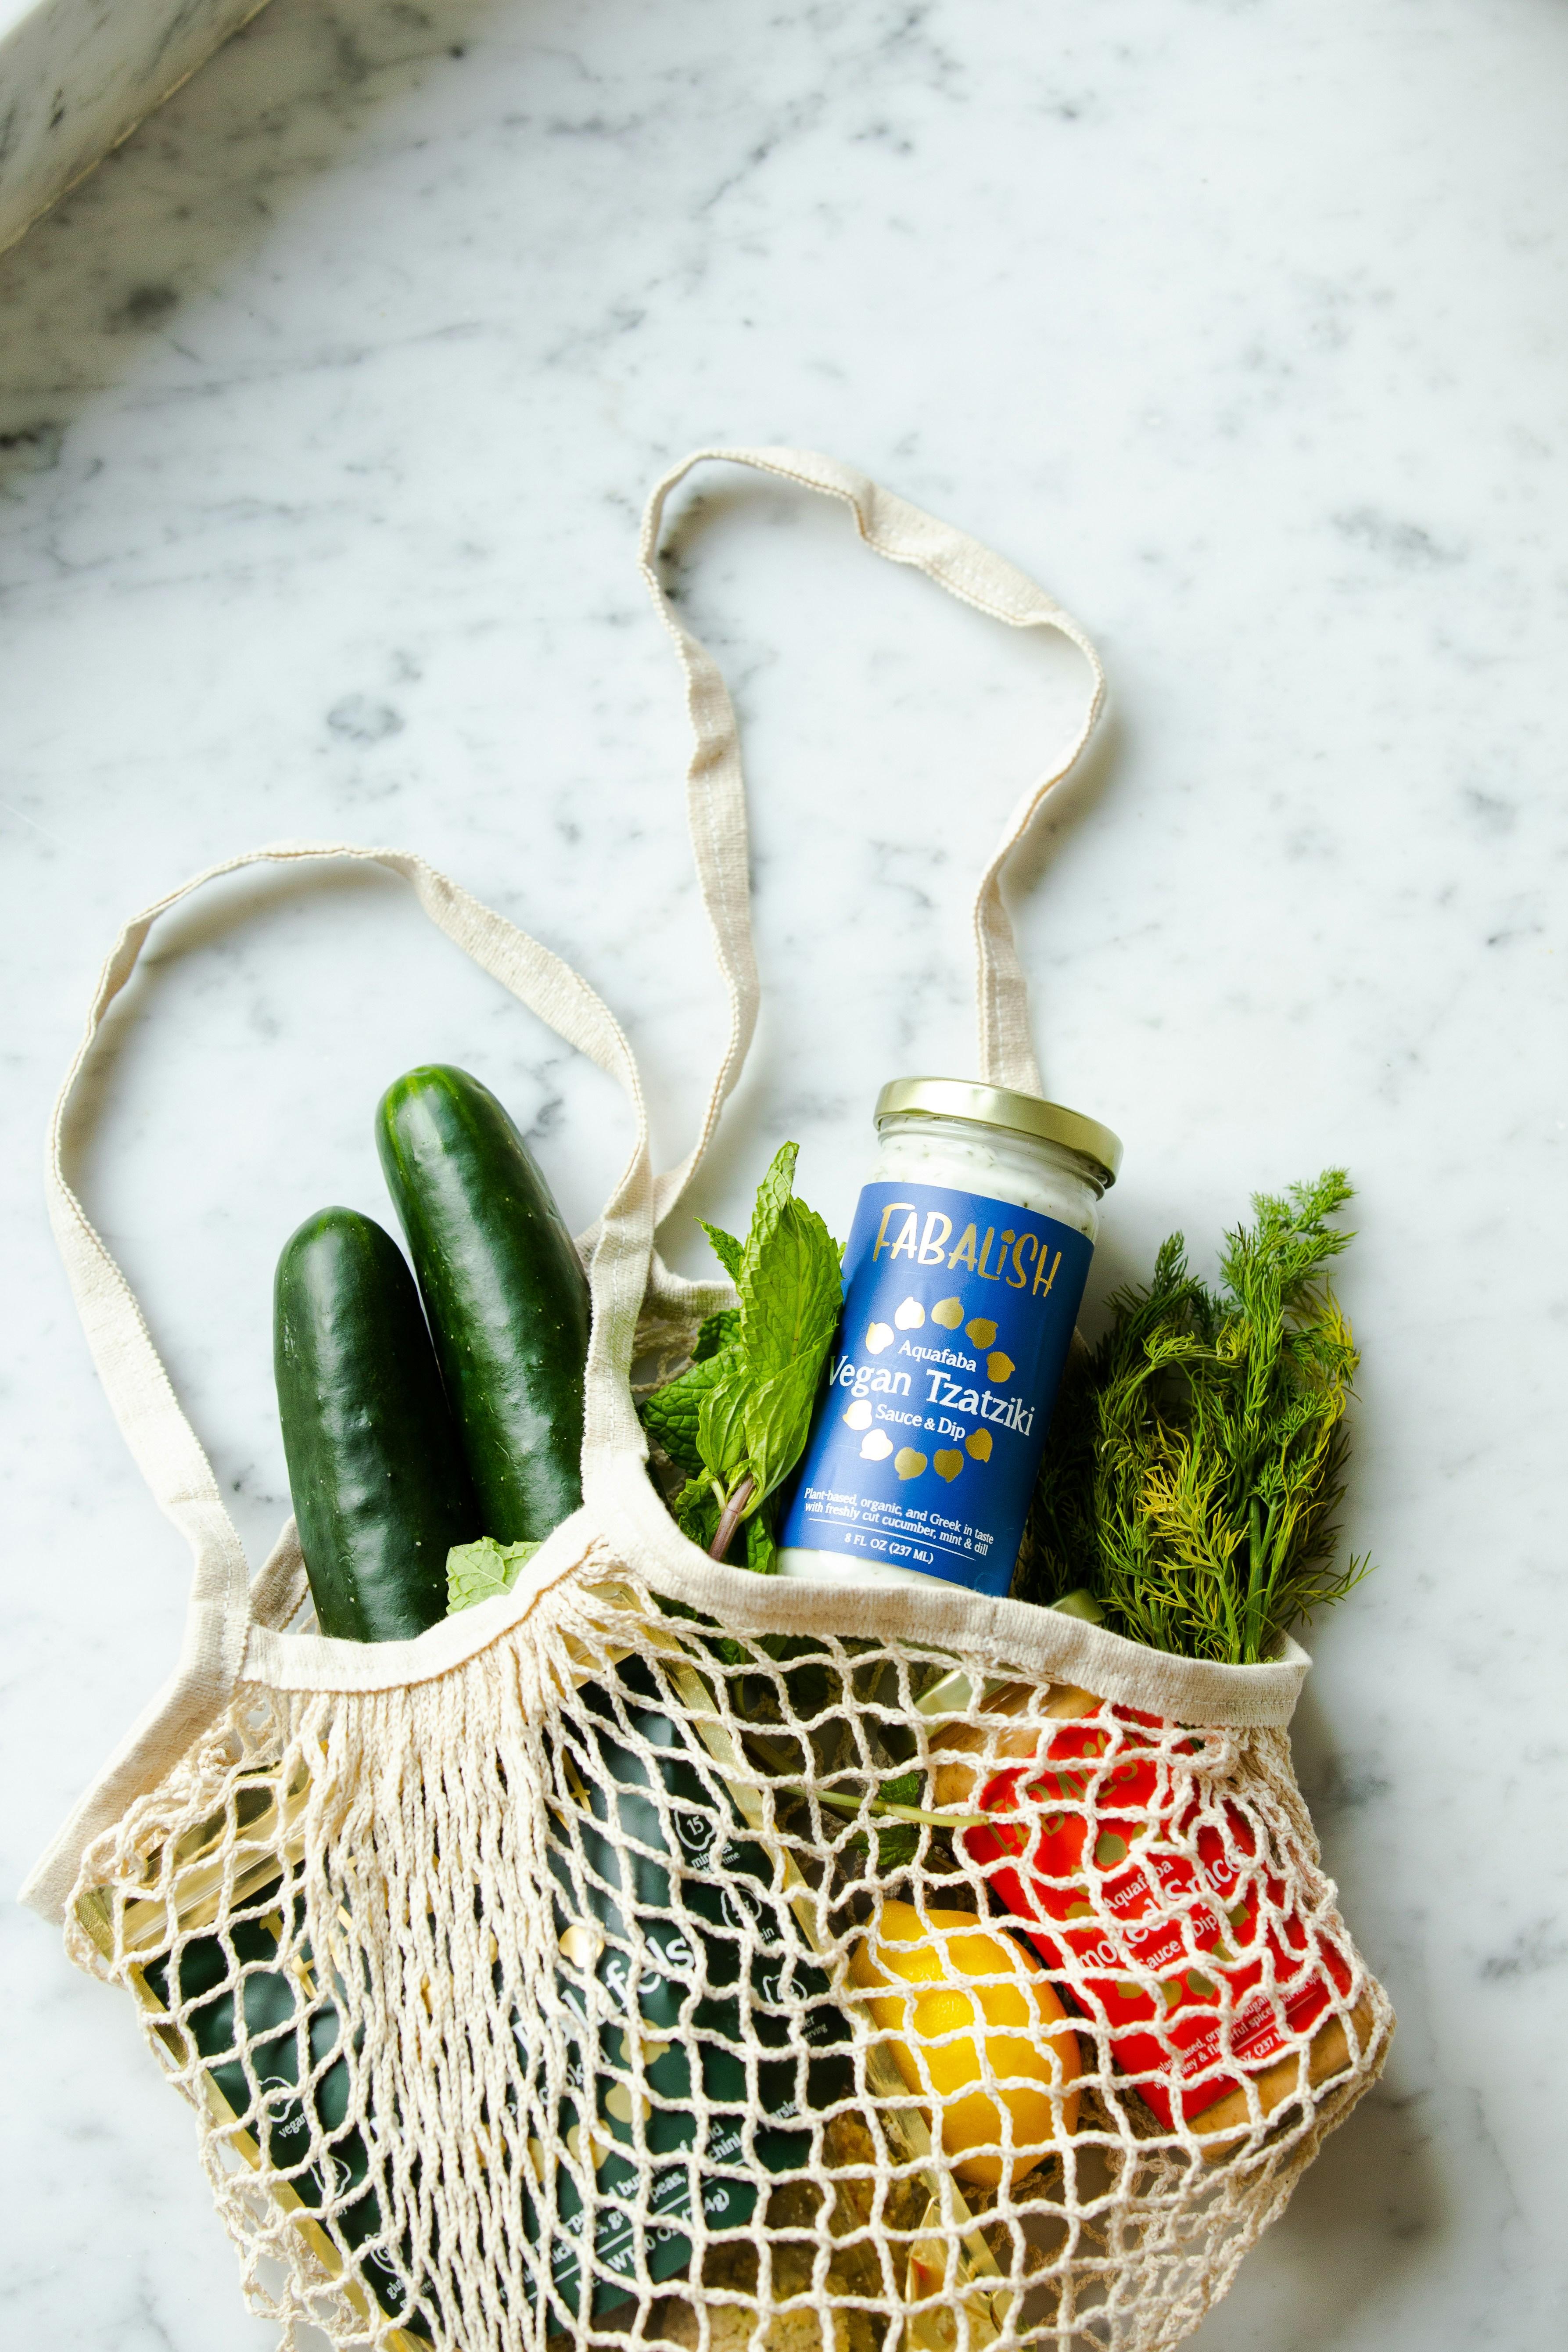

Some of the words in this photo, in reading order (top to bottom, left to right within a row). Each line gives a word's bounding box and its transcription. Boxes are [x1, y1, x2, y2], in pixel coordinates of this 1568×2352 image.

[897, 1340, 976, 1372] Aquafaba
[829, 1355, 912, 1397] Vegan
[926, 1369, 1035, 1436] Tzatziki
[875, 1404, 922, 1427] Sauce
[924, 1418, 936, 1430] &
[937, 1417, 966, 1442] Dip
[804, 1488, 857, 1506] Plant-based,
[861, 1498, 902, 1516] organic,
[905, 1508, 927, 1522] and
[930, 1514, 962, 1533] Greek
[964, 1524, 973, 1537] in
[974, 1529, 994, 1545] taste
[805, 1502, 823, 1513] with
[825, 1504, 861, 1521] freshly
[862, 1512, 879, 1523] cut
[882, 1516, 936, 1540] cucumber,
[939, 1531, 962, 1546] mint
[964, 1540, 972, 1550] &
[974, 1543, 988, 1556] dill
[844, 1533, 851, 1543] 8
[853, 1534, 867, 1547] FL
[870, 1539, 887, 1551] OZ
[889, 1541, 912, 1557] (237
[912, 1548, 934, 1565] ML)
[686, 1815, 704, 1835] 15
[1192, 1913, 1218, 1939] Dip
[1253, 2036, 1274, 2057] (237
